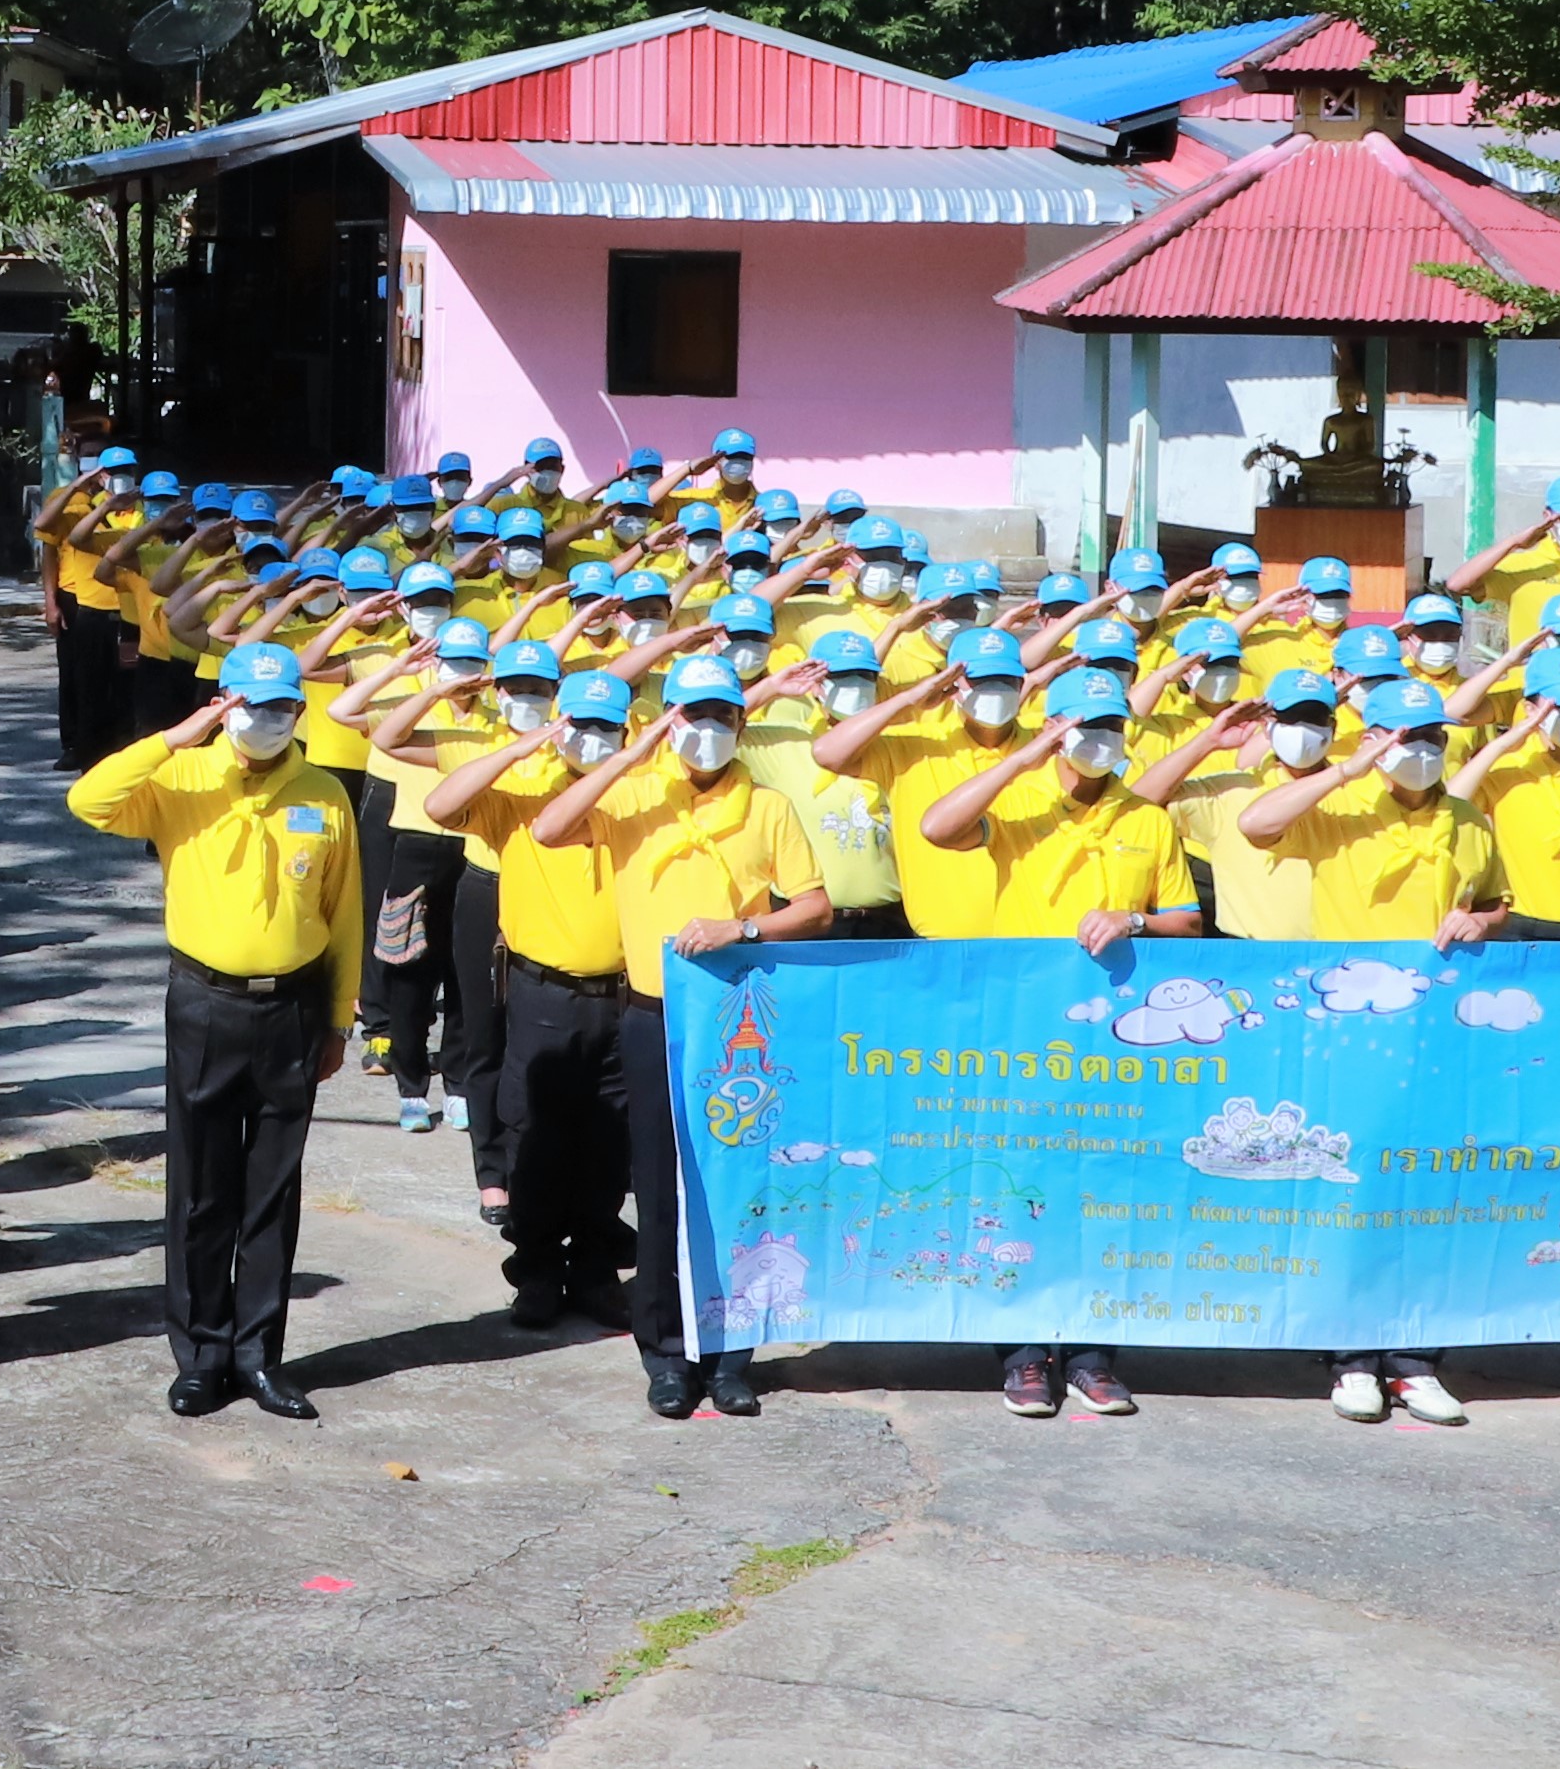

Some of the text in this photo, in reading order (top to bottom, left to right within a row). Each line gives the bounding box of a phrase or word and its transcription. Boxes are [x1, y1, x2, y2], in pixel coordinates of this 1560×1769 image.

[839, 1032, 1228, 1085] โครงการจิตอาสา
[1080, 1192, 1173, 1221] จิตอาสา
[1101, 1242, 1173, 1270] อำเภอ
[1090, 1290, 1263, 1323] จังหวัด ยโสธร
